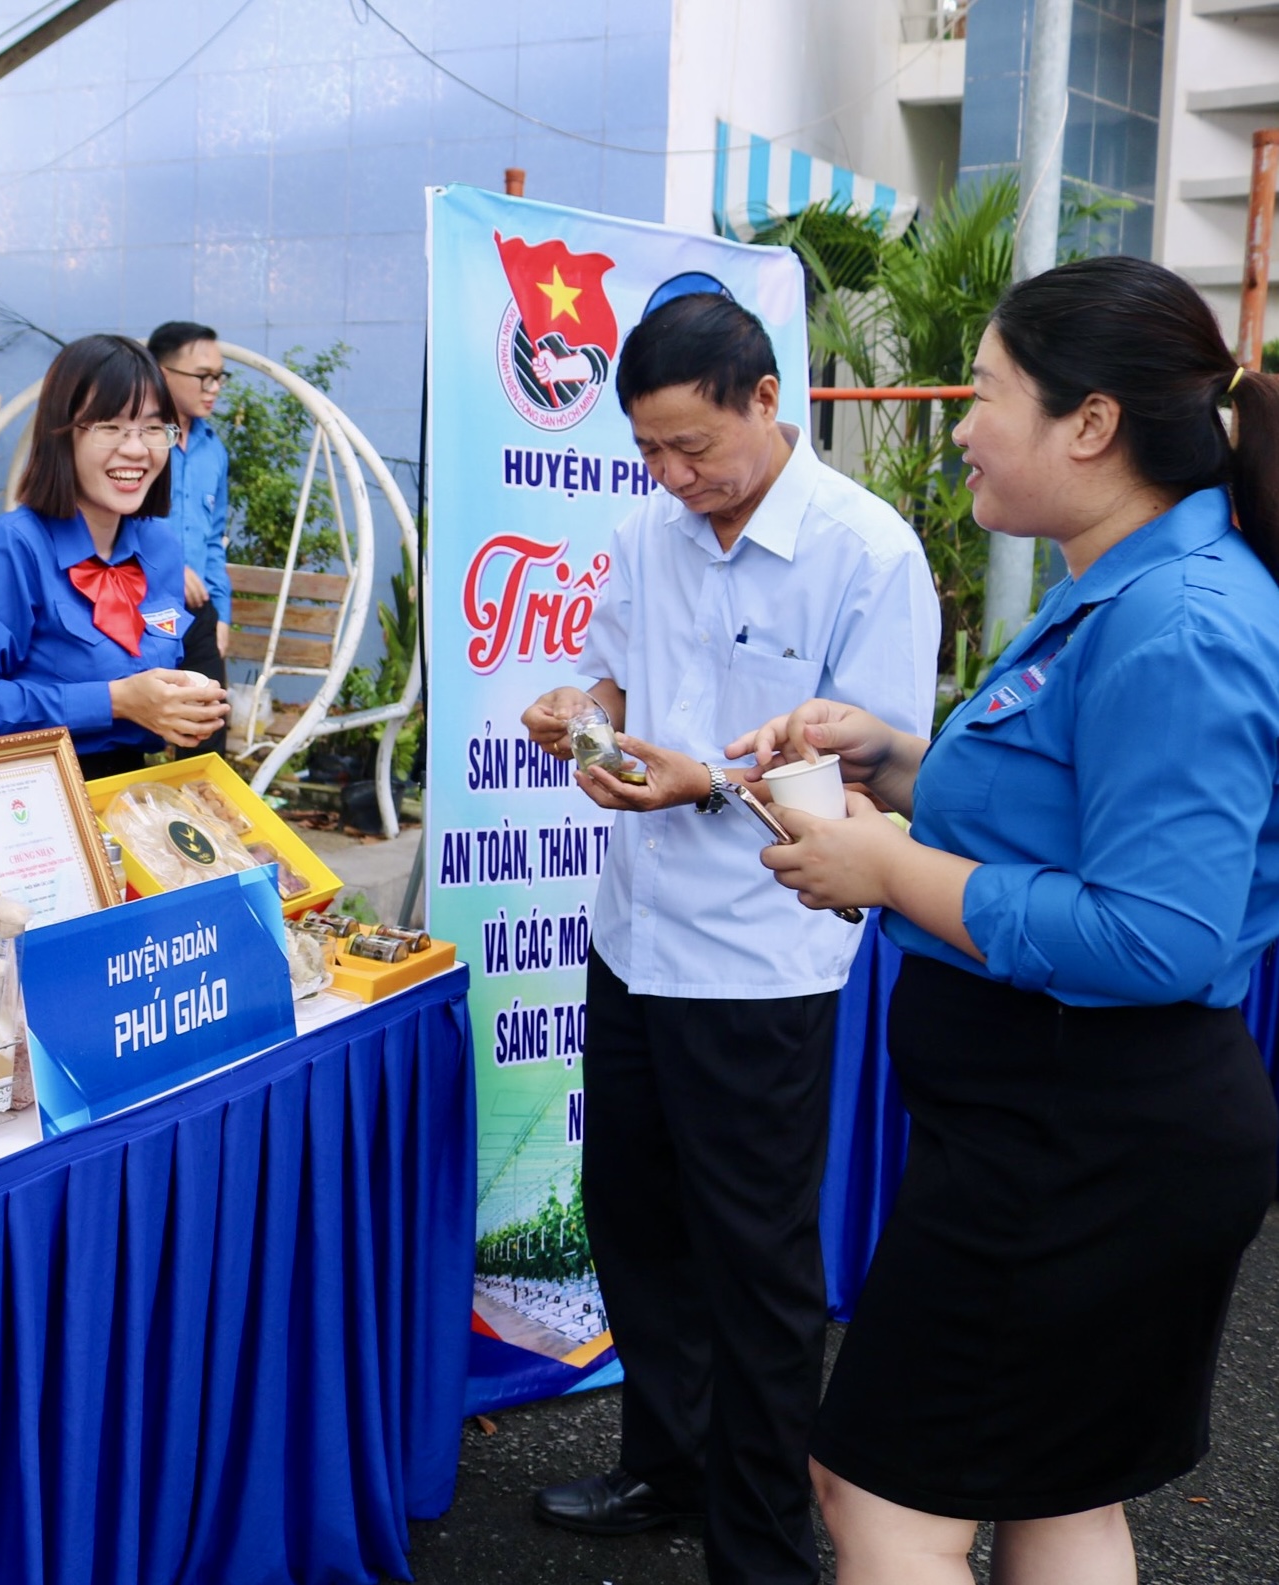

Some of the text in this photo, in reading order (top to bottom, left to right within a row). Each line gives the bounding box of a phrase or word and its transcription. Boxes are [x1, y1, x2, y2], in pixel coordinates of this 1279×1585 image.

[500, 339, 510, 371] THANH
[582, 387, 597, 411] MINH
[504, 448, 658, 498] HUYỆN PH
[463, 534, 610, 669] Triể
[468, 720, 508, 790] SẢN
[440, 816, 614, 887] AN TOÀN, THÂN TH
[107, 920, 218, 987] HUYỆN ĐOÀN
[484, 904, 589, 974] VÀ CÁC MÔ
[114, 970, 228, 1059] PHÚ GIÁO
[496, 1000, 548, 1064] SÁNG
[569, 1092, 583, 1142] N
